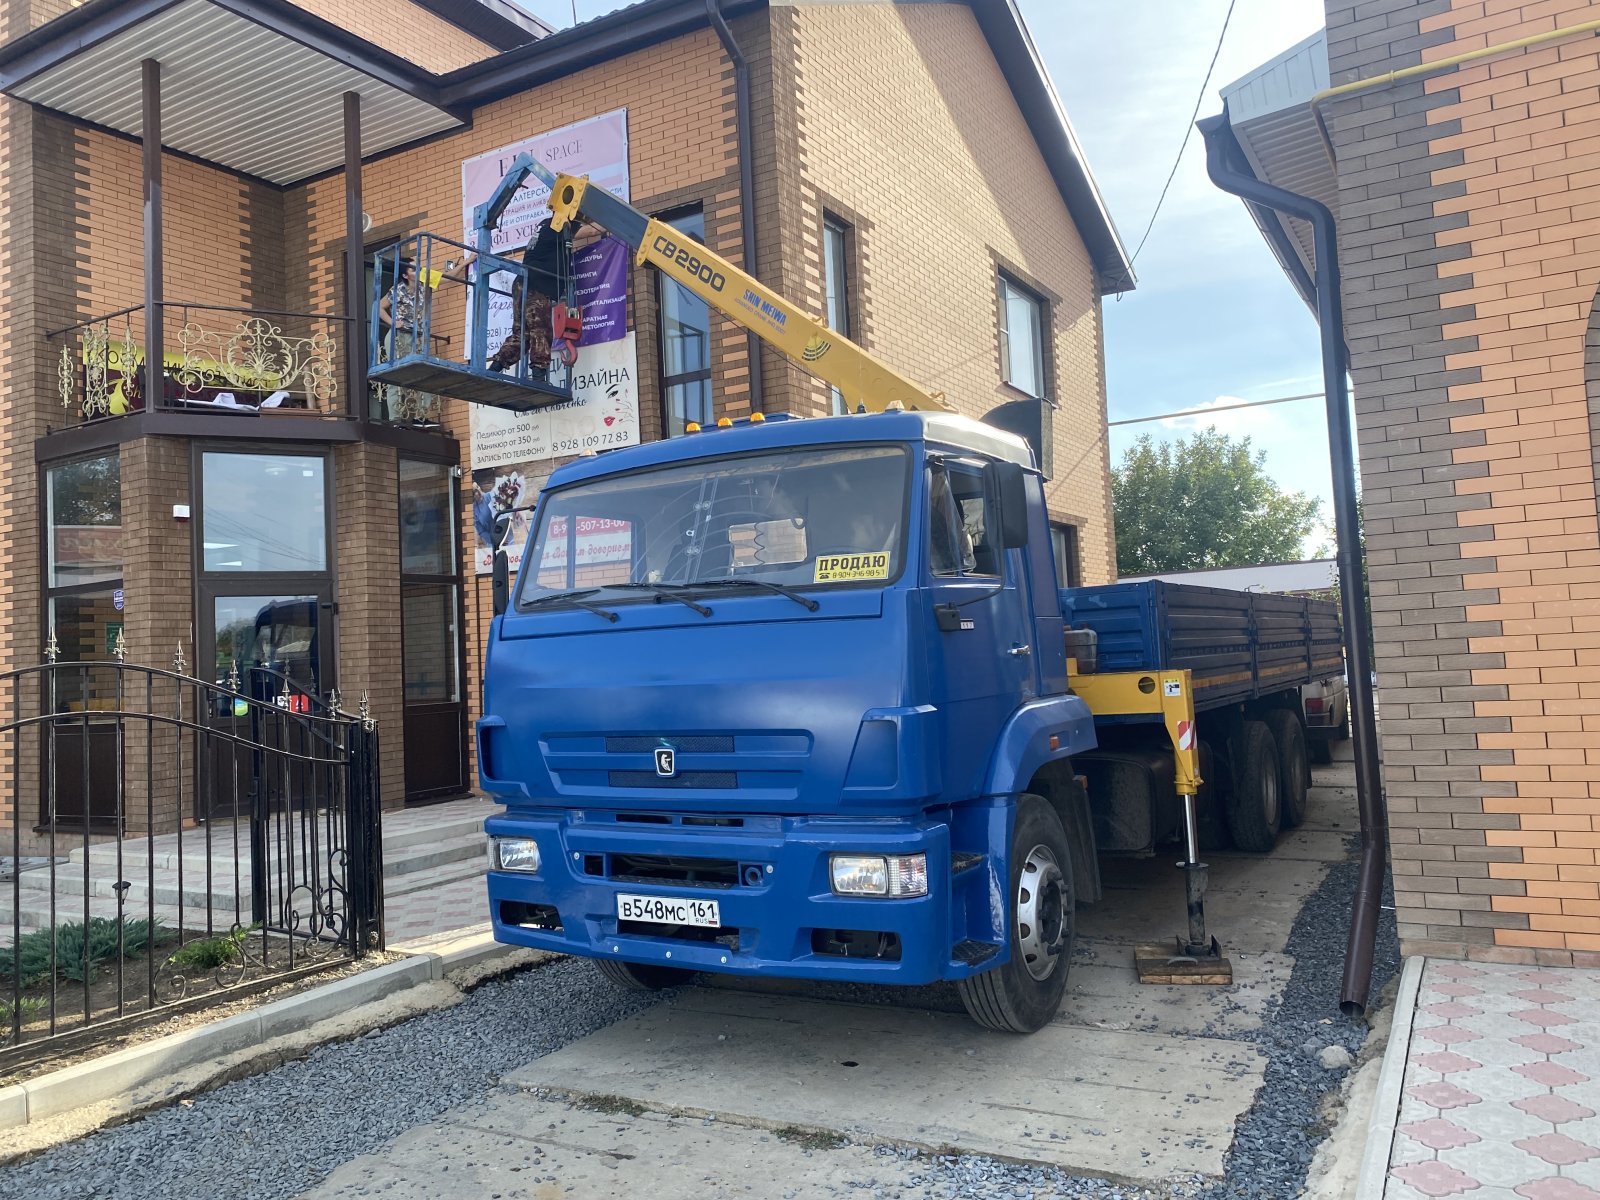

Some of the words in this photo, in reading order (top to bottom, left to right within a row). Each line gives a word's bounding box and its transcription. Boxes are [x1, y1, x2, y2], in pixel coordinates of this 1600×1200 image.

[545, 138, 583, 163] SPACE
[743, 288, 761, 308] SHIN
[761, 301, 787, 326] MEIWA
[477, 429, 507, 440] Педикюр
[516, 423, 531, 433] 500
[477, 441, 508, 451] Маникюр
[517, 435, 532, 445] 350
[552, 442, 559, 452] 8
[560, 438, 579, 451] 928
[582, 435, 600, 448] 109
[602, 433, 613, 444] 72
[616, 431, 629, 442] 83
[477, 454, 502, 464] ЗАПИСЬ
[513, 447, 546, 458] ТЕЛЕФОНУ
[818, 555, 886, 571] ПРОДАЮ
[689, 901, 715, 919] 161
